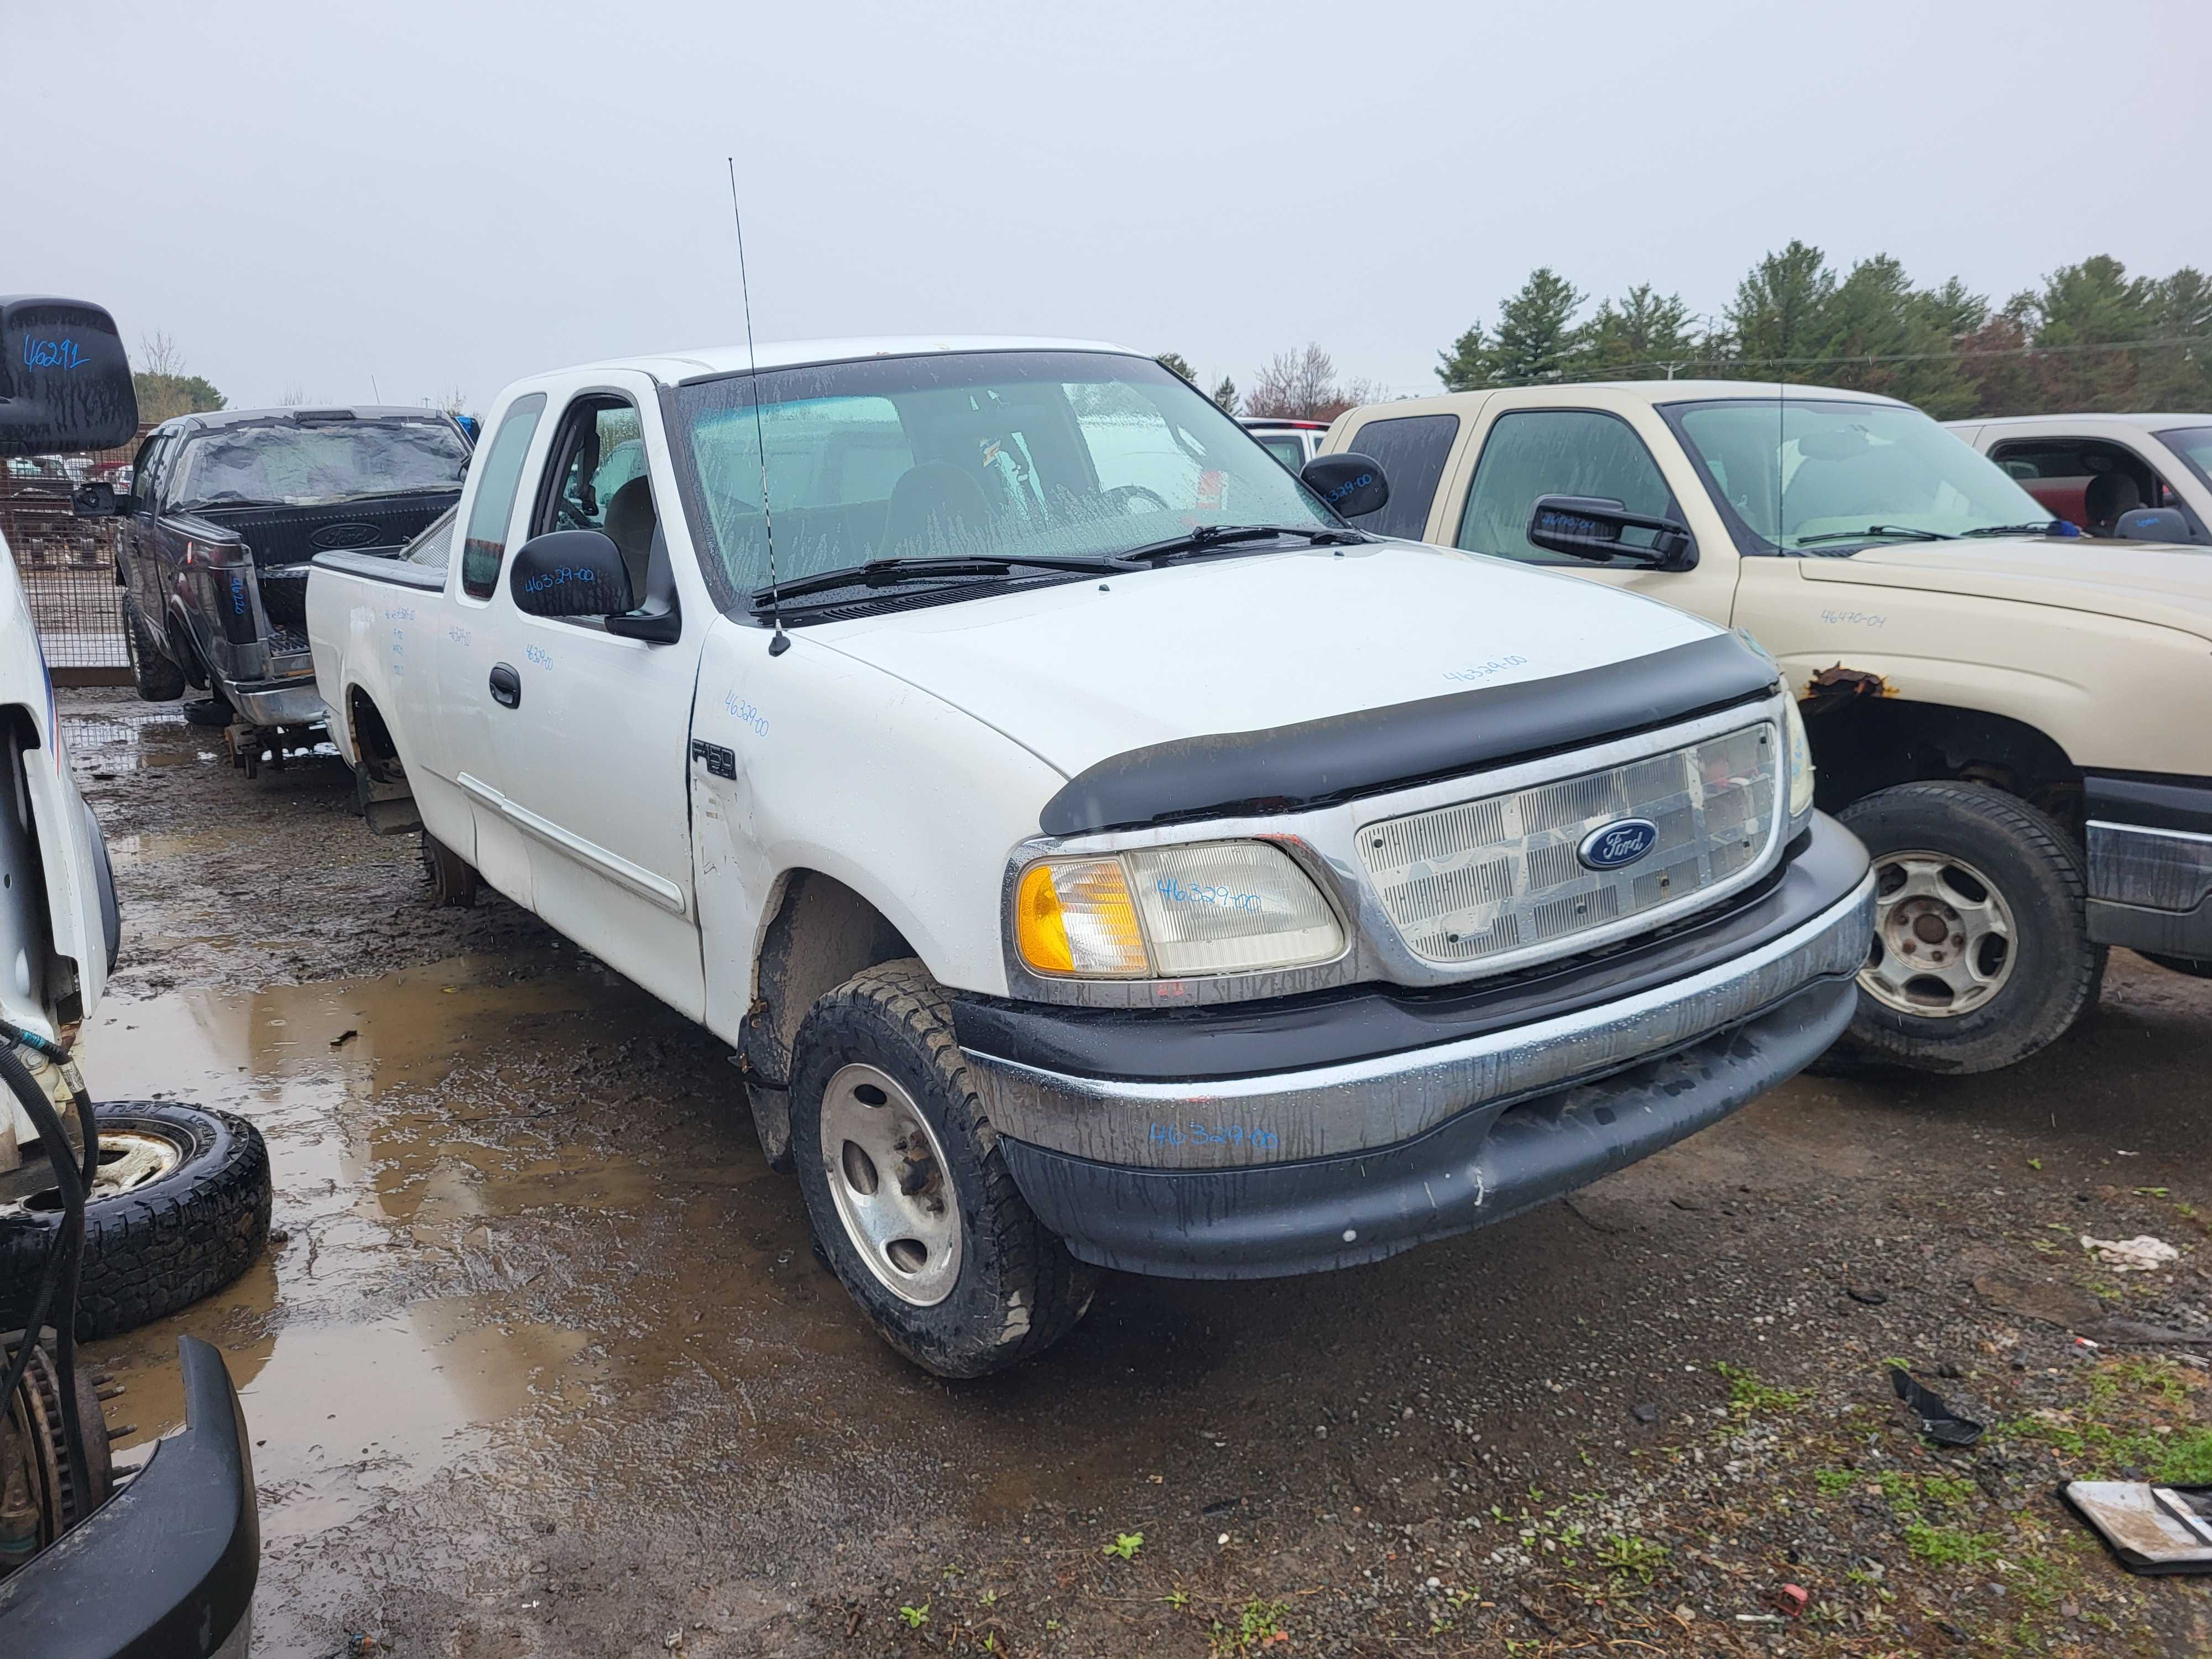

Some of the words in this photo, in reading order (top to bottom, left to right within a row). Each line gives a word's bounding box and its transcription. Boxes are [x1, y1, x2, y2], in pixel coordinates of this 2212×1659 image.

[24, 333, 91, 372] 46291
[1323, 473, 1372, 502] 329-00
[326, 526, 367, 544] Ford
[525, 567, 594, 593] 46329-00
[1820, 609, 1886, 628] 46470-04
[526, 643, 554, 671] 46329-00
[1442, 655, 1527, 682] 46329-00
[725, 690, 769, 737] 46329-00
[1603, 828, 1644, 859] Ford
[1157, 878, 1261, 911] 46329-00
[1150, 1123, 1279, 1149] 46329-00
